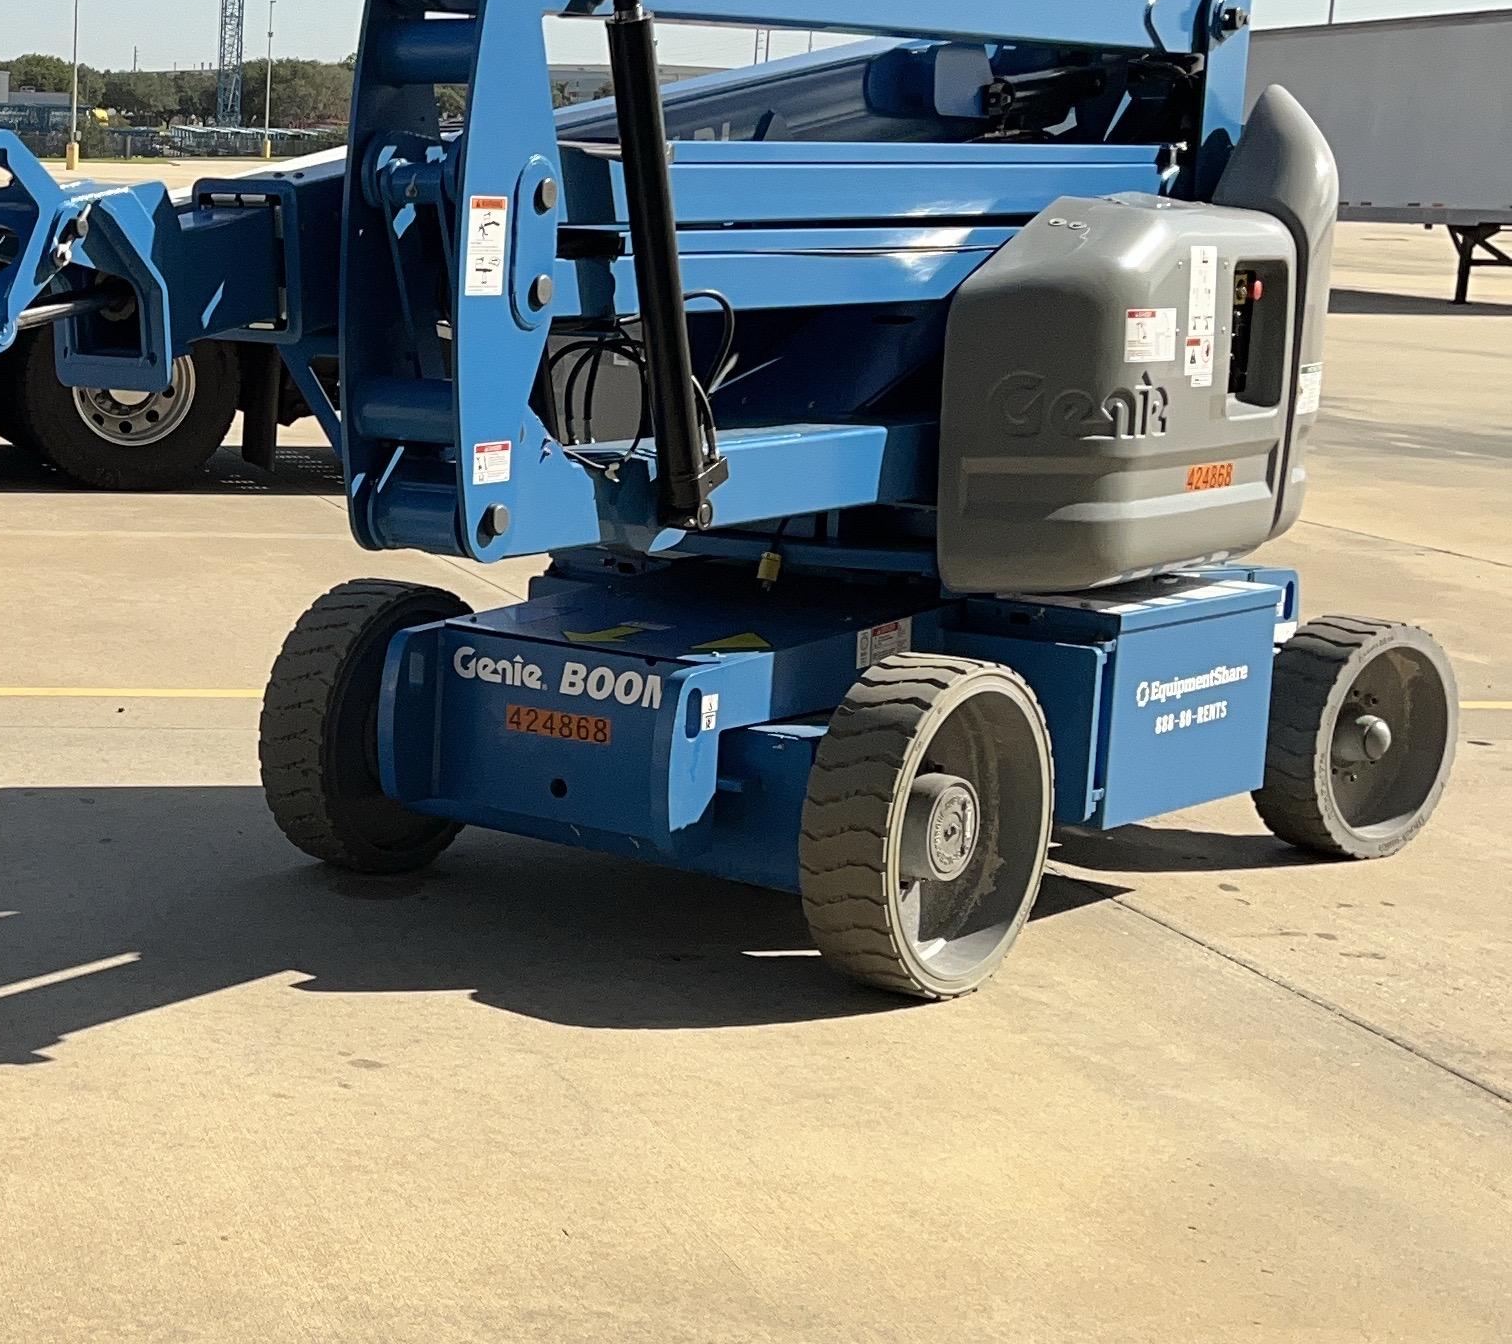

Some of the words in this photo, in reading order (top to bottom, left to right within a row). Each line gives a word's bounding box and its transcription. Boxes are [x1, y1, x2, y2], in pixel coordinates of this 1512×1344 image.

[1187, 463, 1233, 490] 424868
[453, 645, 544, 690] Genie
[1149, 664, 1249, 704] EquipmentShare
[508, 706, 609, 744] 424868
[1154, 700, 1229, 735] 888-80-RENTS
